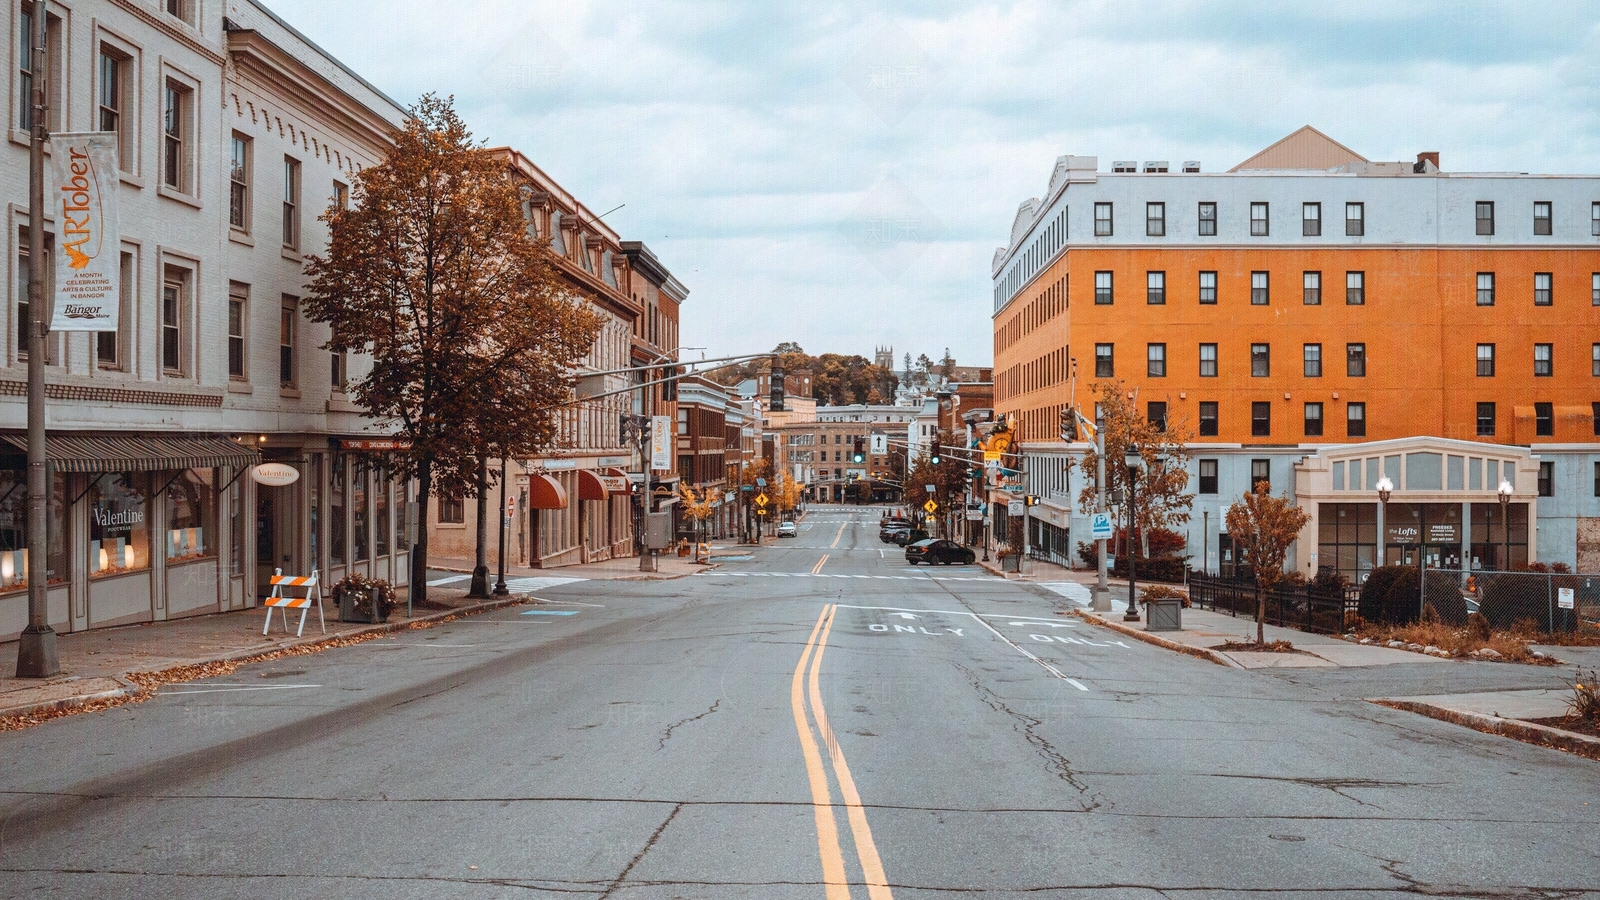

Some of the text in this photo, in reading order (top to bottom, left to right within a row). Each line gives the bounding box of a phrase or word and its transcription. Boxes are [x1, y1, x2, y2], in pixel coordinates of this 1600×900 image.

[61, 146, 91, 258] ARTober
[64, 304, 102, 316] Bangor
[257, 469, 294, 477] Valentine
[94, 508, 144, 526] Valentine
[1398, 527, 1418, 536] Lofts
[868, 624, 965, 637] ONLY
[1029, 634, 1131, 649] ONLY
